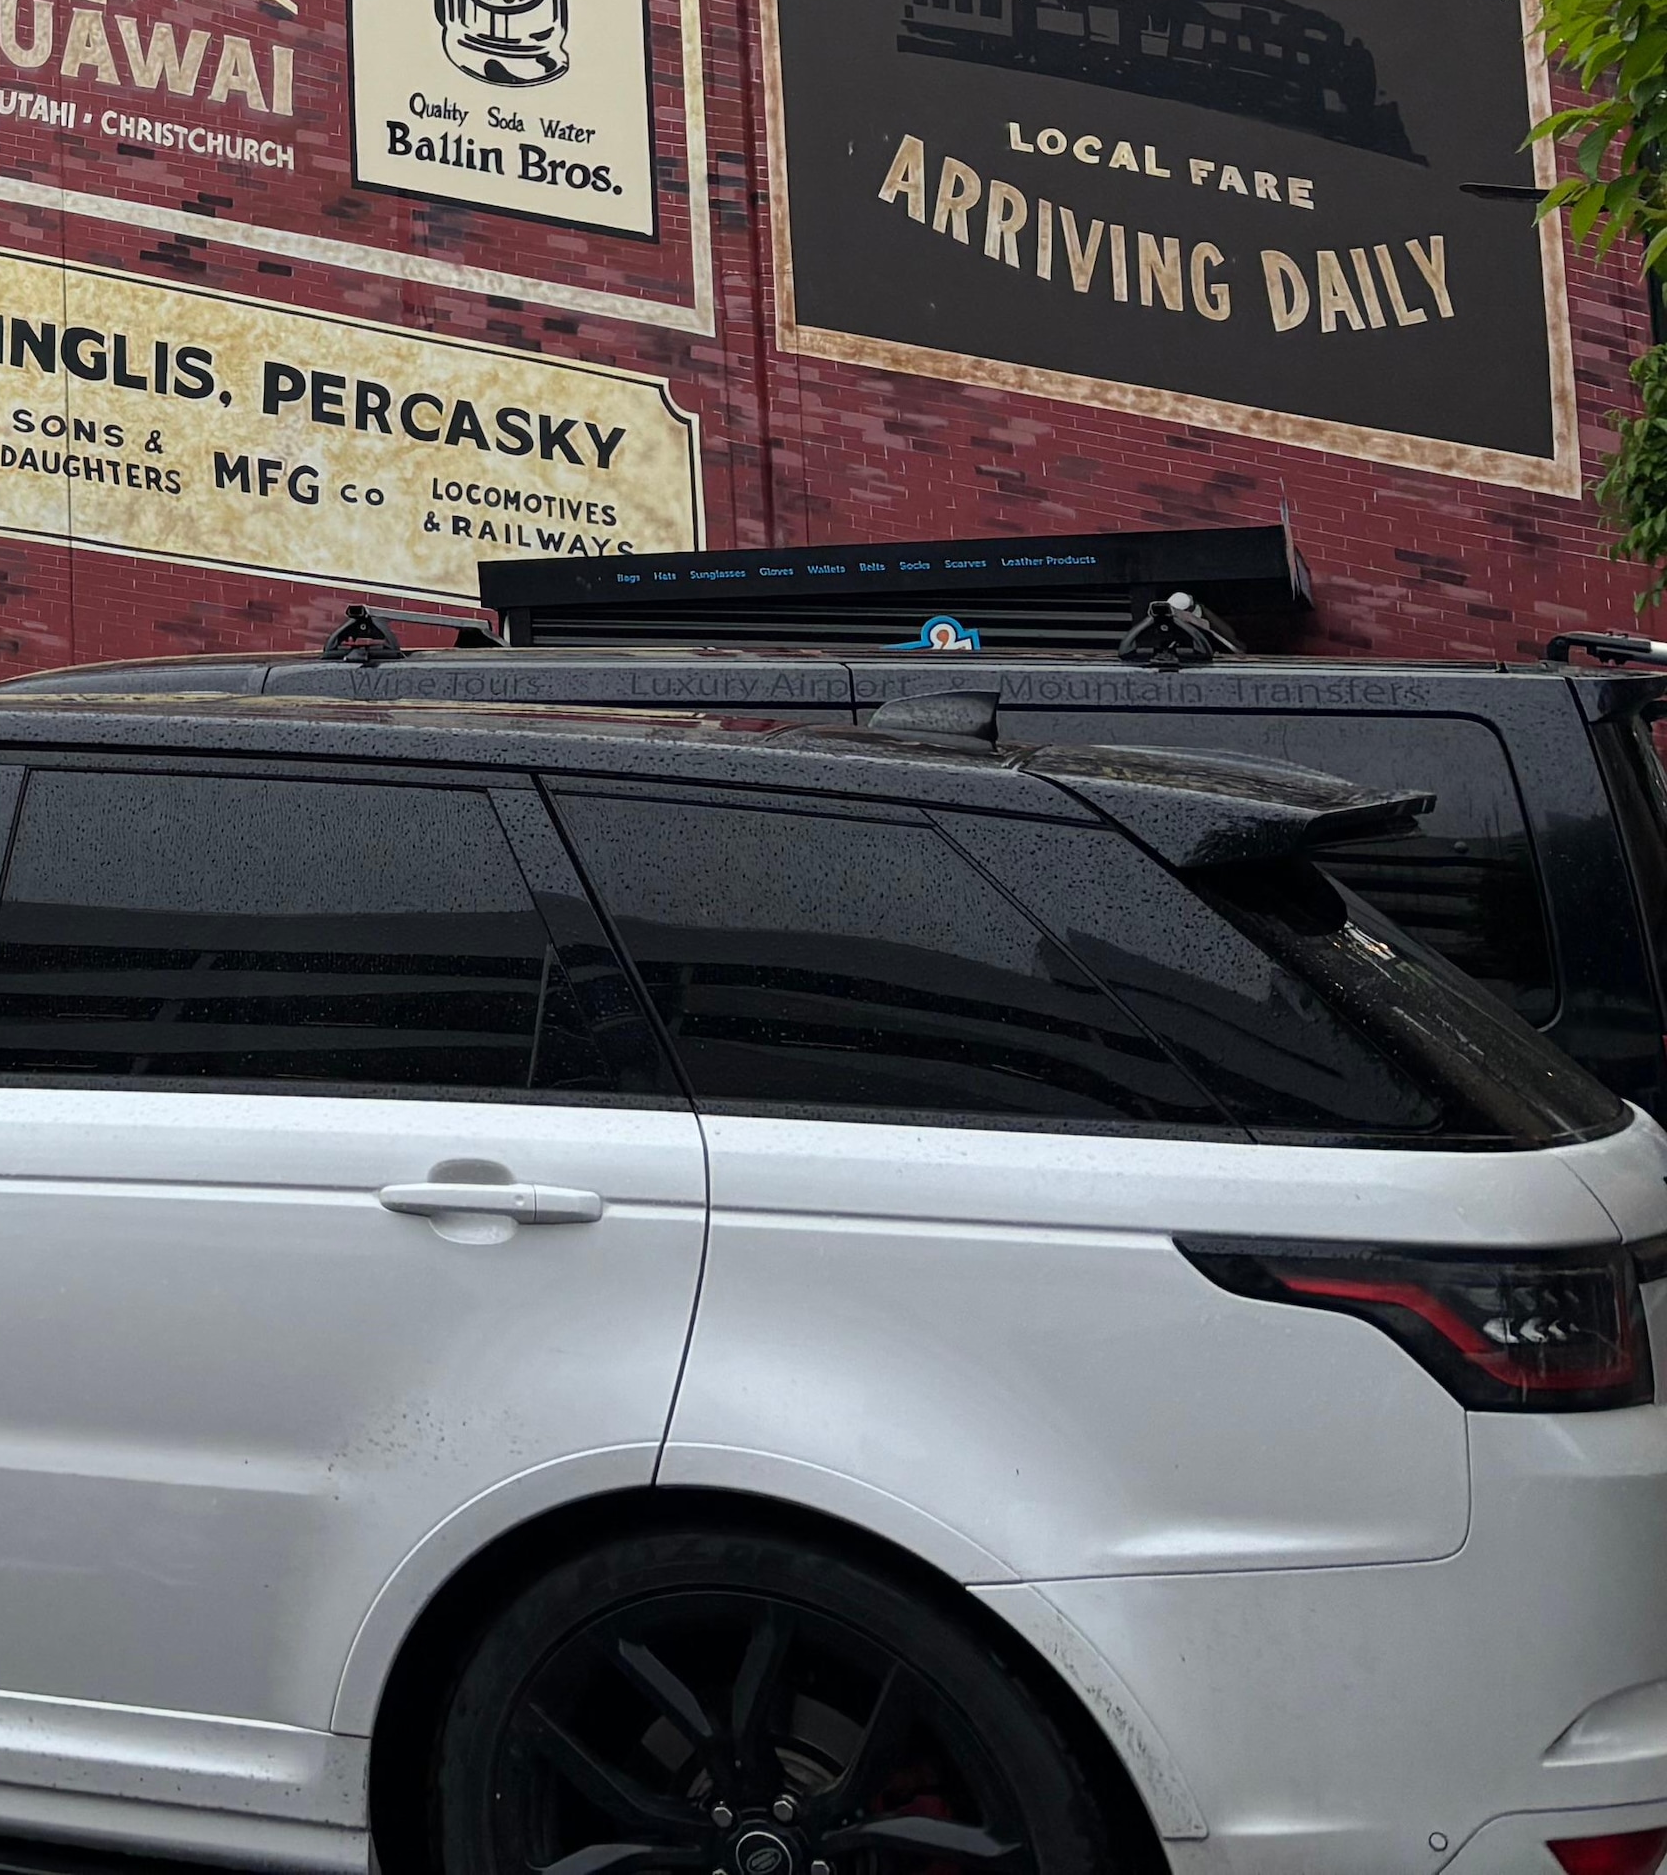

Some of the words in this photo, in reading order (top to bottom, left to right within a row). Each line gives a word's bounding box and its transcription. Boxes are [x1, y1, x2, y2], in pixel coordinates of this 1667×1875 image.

[101, 113, 294, 171] CHRISTCHURCH
[408, 93, 469, 126] Quality
[488, 106, 526, 133] Soda
[540, 116, 596, 145] Water
[387, 121, 506, 176] Ballin
[519, 143, 624, 196] Bros.
[1009, 121, 1171, 179] LOCAL
[1190, 158, 1316, 210] FARE
[877, 133, 1232, 322] ARRIVING
[1261, 235, 1454, 333] DAILY
[12, 408, 125, 448] SONS
[143, 429, 164, 454] &
[263, 360, 625, 470] PERCASKY
[0, 444, 181, 495] DAUGHTERS
[214, 451, 320, 505] MFG
[340, 482, 386, 507] CO
[432, 477, 617, 527] LOCOMOTIVES
[424, 511, 442, 532] &
[452, 515, 634, 556] RAILWAYS
[630, 671, 760, 703] Luxury
[771, 671, 912, 702] Airport
[1001, 675, 1202, 702] Mountain
